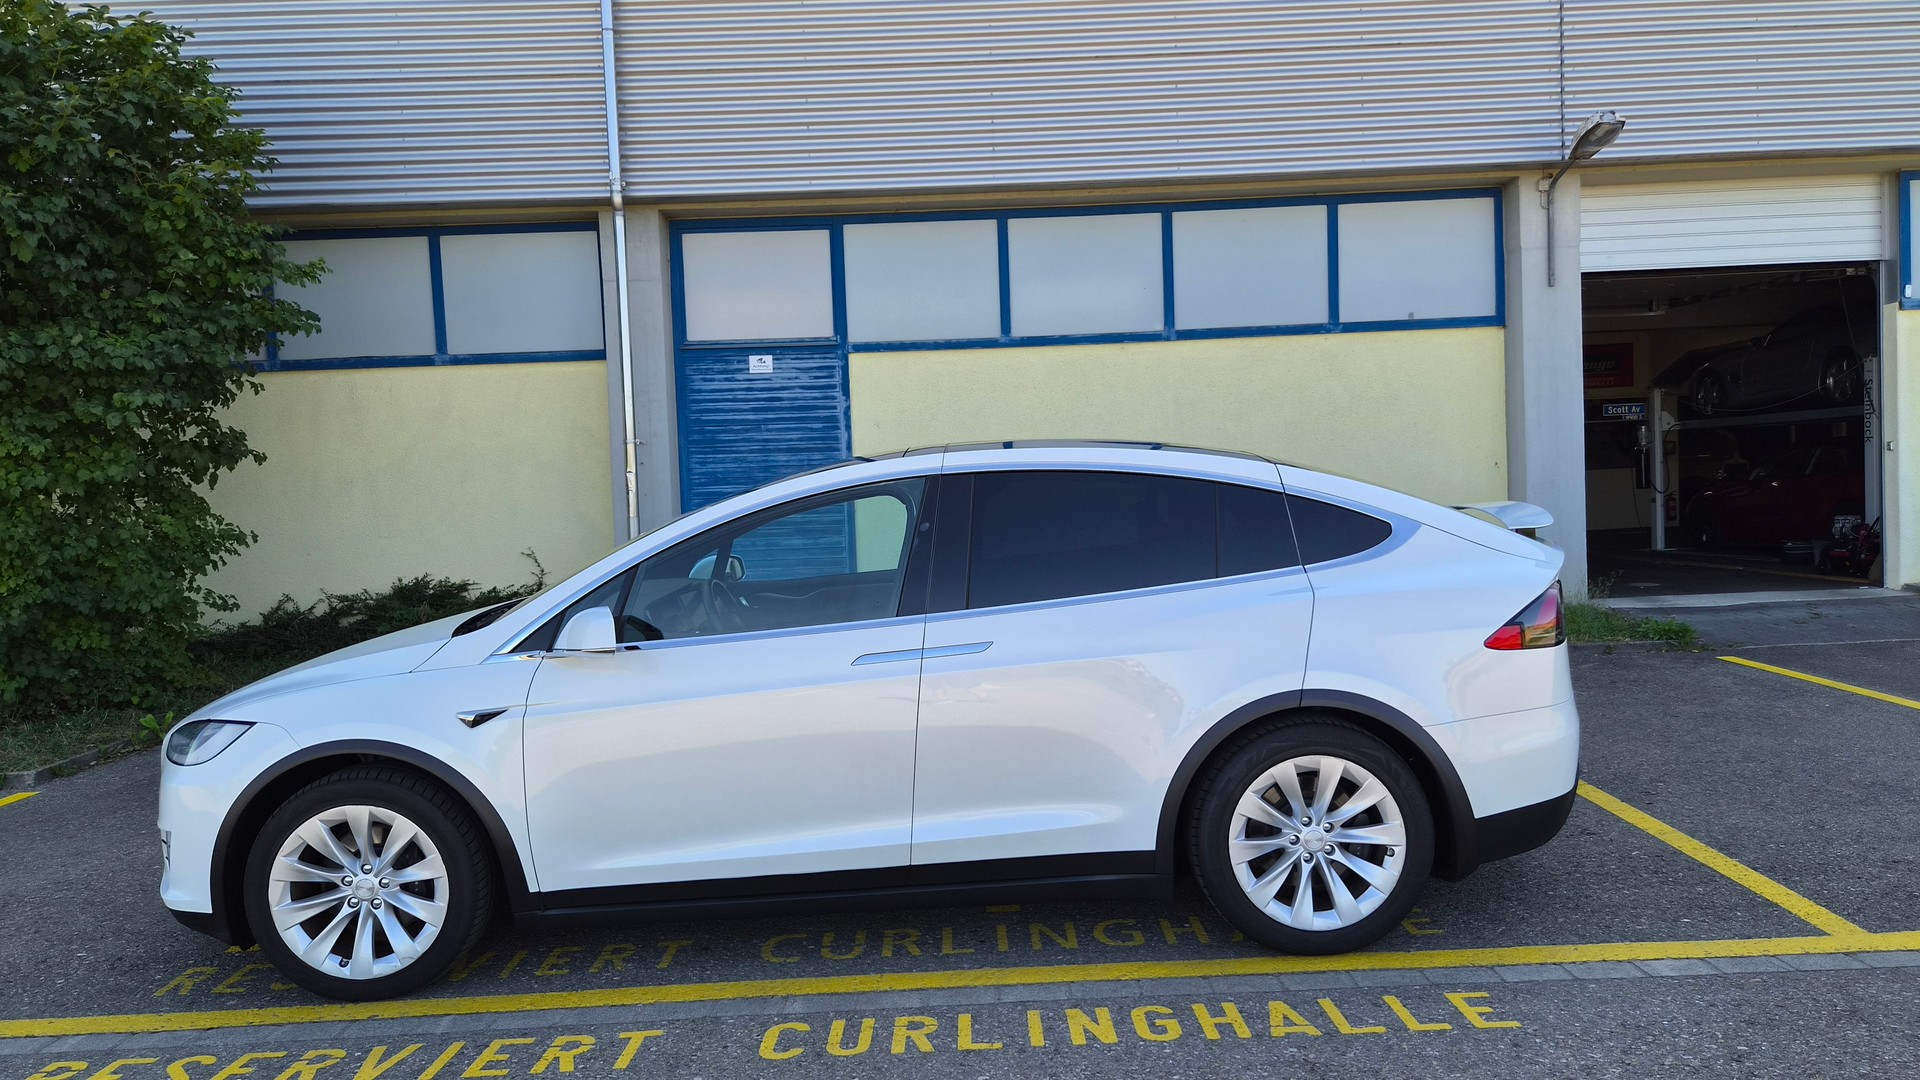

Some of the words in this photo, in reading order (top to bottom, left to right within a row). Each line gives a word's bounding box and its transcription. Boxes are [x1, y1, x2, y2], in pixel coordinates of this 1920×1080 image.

[1607, 405, 1629, 414] Scott
[153, 939, 694, 998] REVIERT
[759, 907, 1444, 964] CURLINGHE
[759, 992, 1521, 1061] CURLINGHALLE
